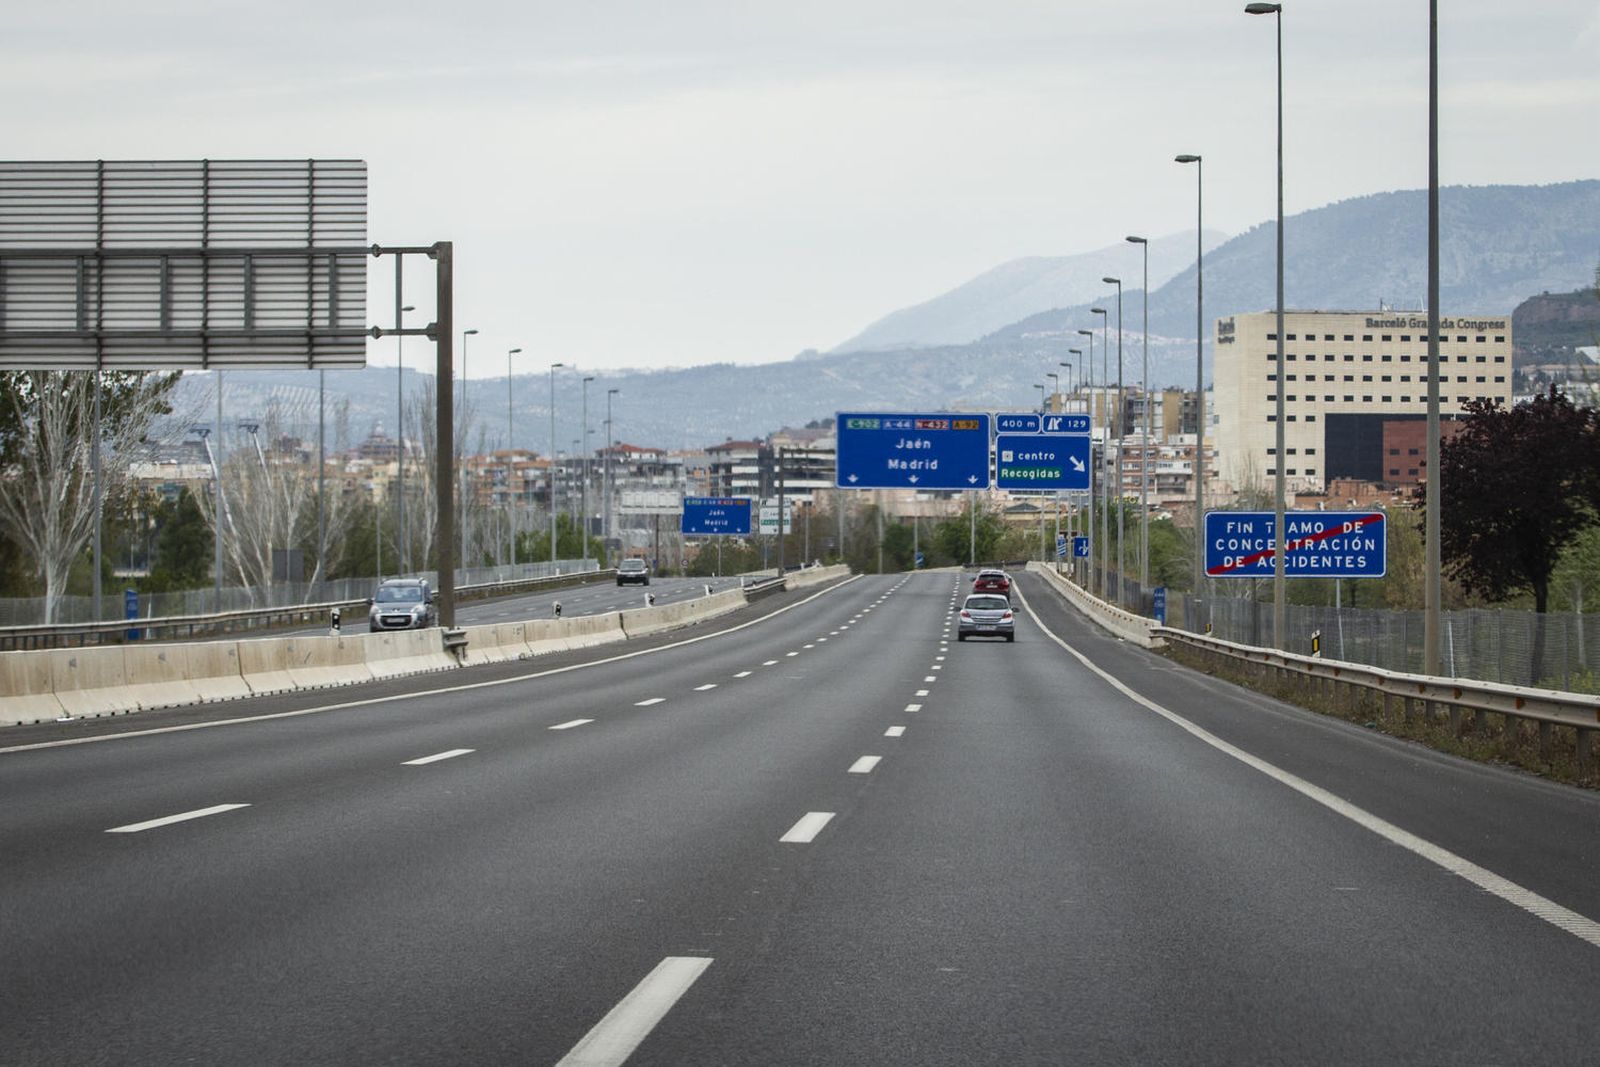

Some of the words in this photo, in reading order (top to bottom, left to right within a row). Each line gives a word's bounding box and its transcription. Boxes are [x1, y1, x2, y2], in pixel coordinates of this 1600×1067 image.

[1366, 317, 1406, 328] Barceló
[1409, 318, 1454, 329] Grada
[1457, 319, 1505, 332] Congress
[1002, 420, 1023, 428] 400
[1068, 420, 1086, 428] 129
[896, 438, 931, 449] Jaén
[1018, 452, 1055, 460] centro
[888, 459, 938, 470] Madrid
[1001, 469, 1060, 480] Recogidas
[1226, 522, 1253, 534] FIN
[1265, 522, 1324, 534] TAMO
[1343, 522, 1364, 534] DE
[1223, 556, 1245, 568] DE
